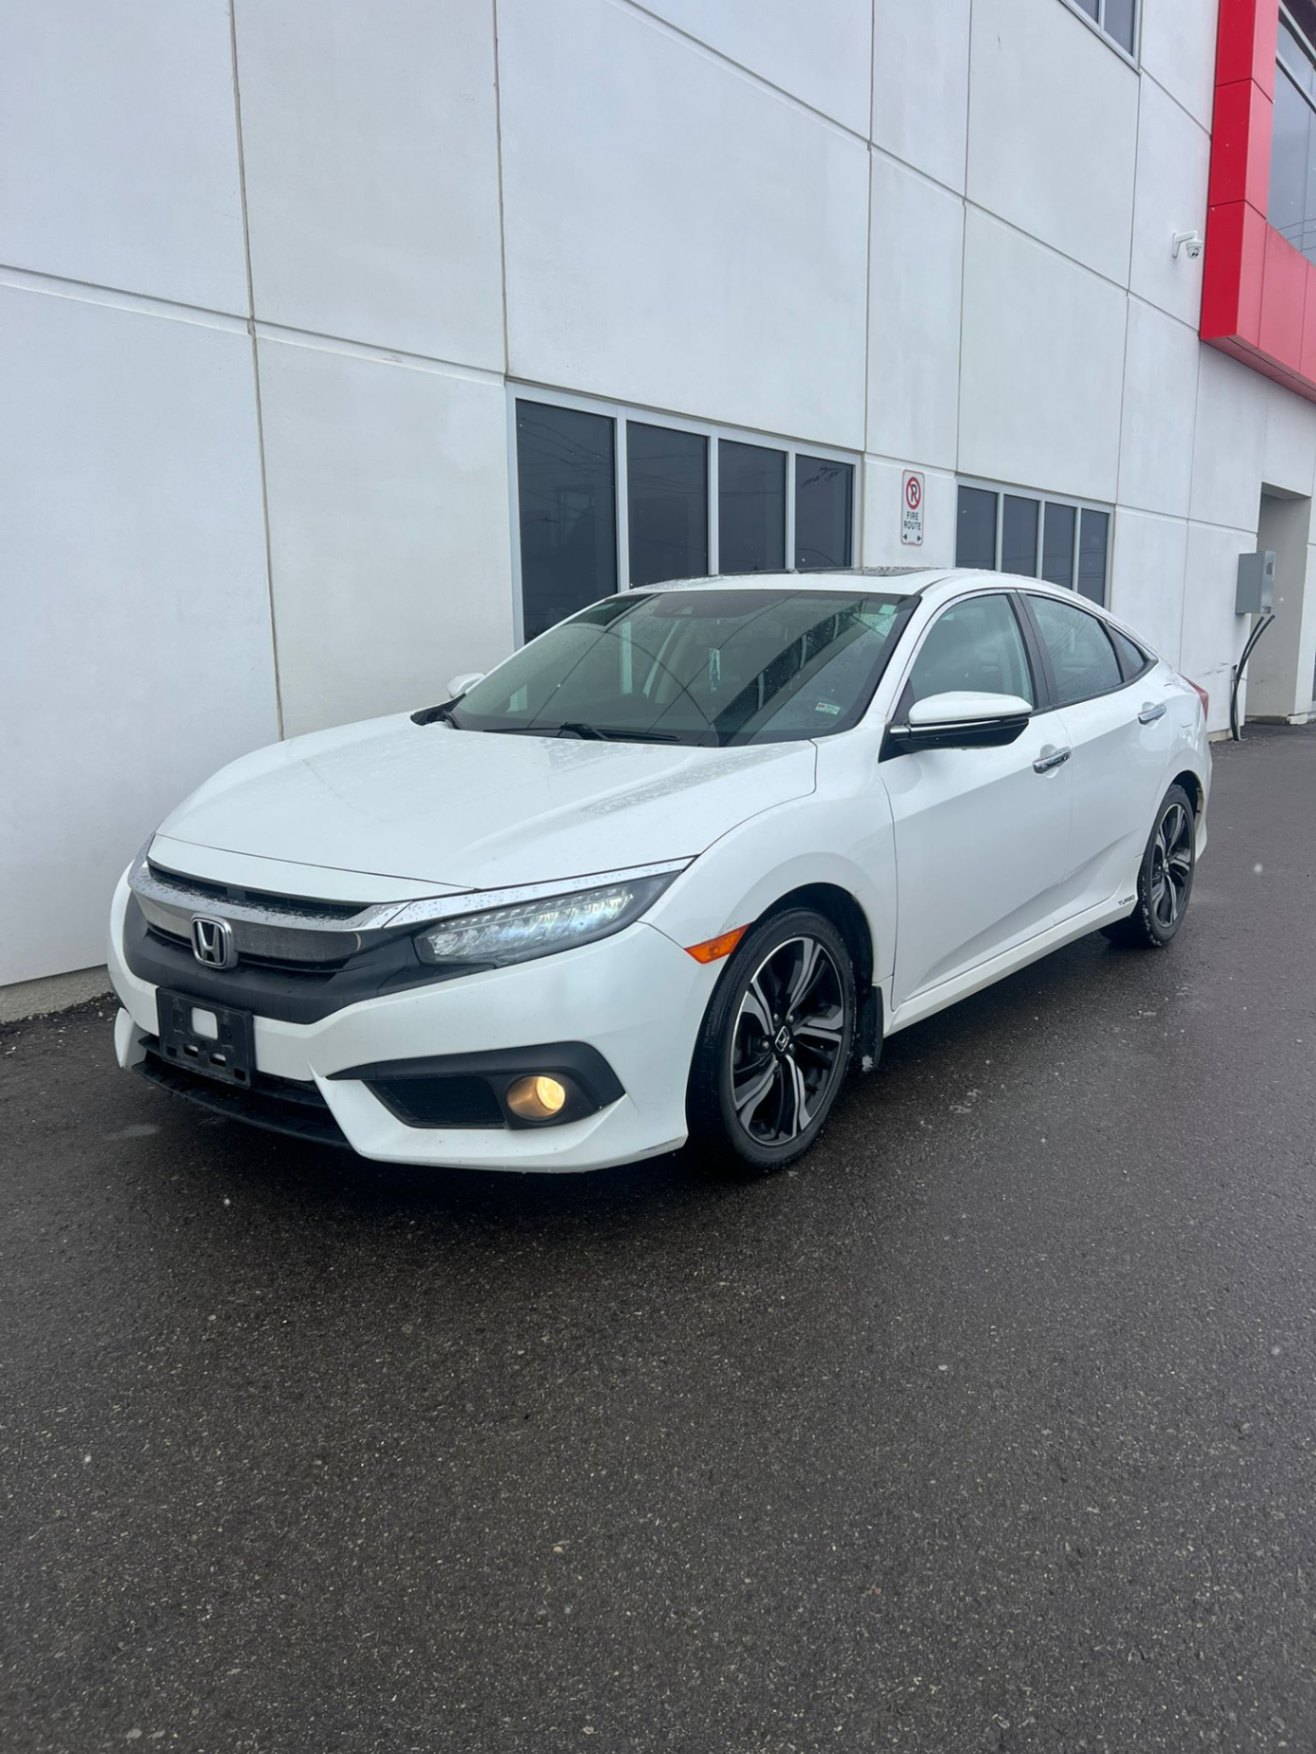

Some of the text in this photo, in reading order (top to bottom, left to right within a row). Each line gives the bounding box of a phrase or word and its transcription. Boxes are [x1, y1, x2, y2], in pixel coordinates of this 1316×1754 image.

[907, 511, 919, 521] FIRE
[904, 520, 921, 531] ROUTE
[1118, 894, 1136, 906] TURBO
